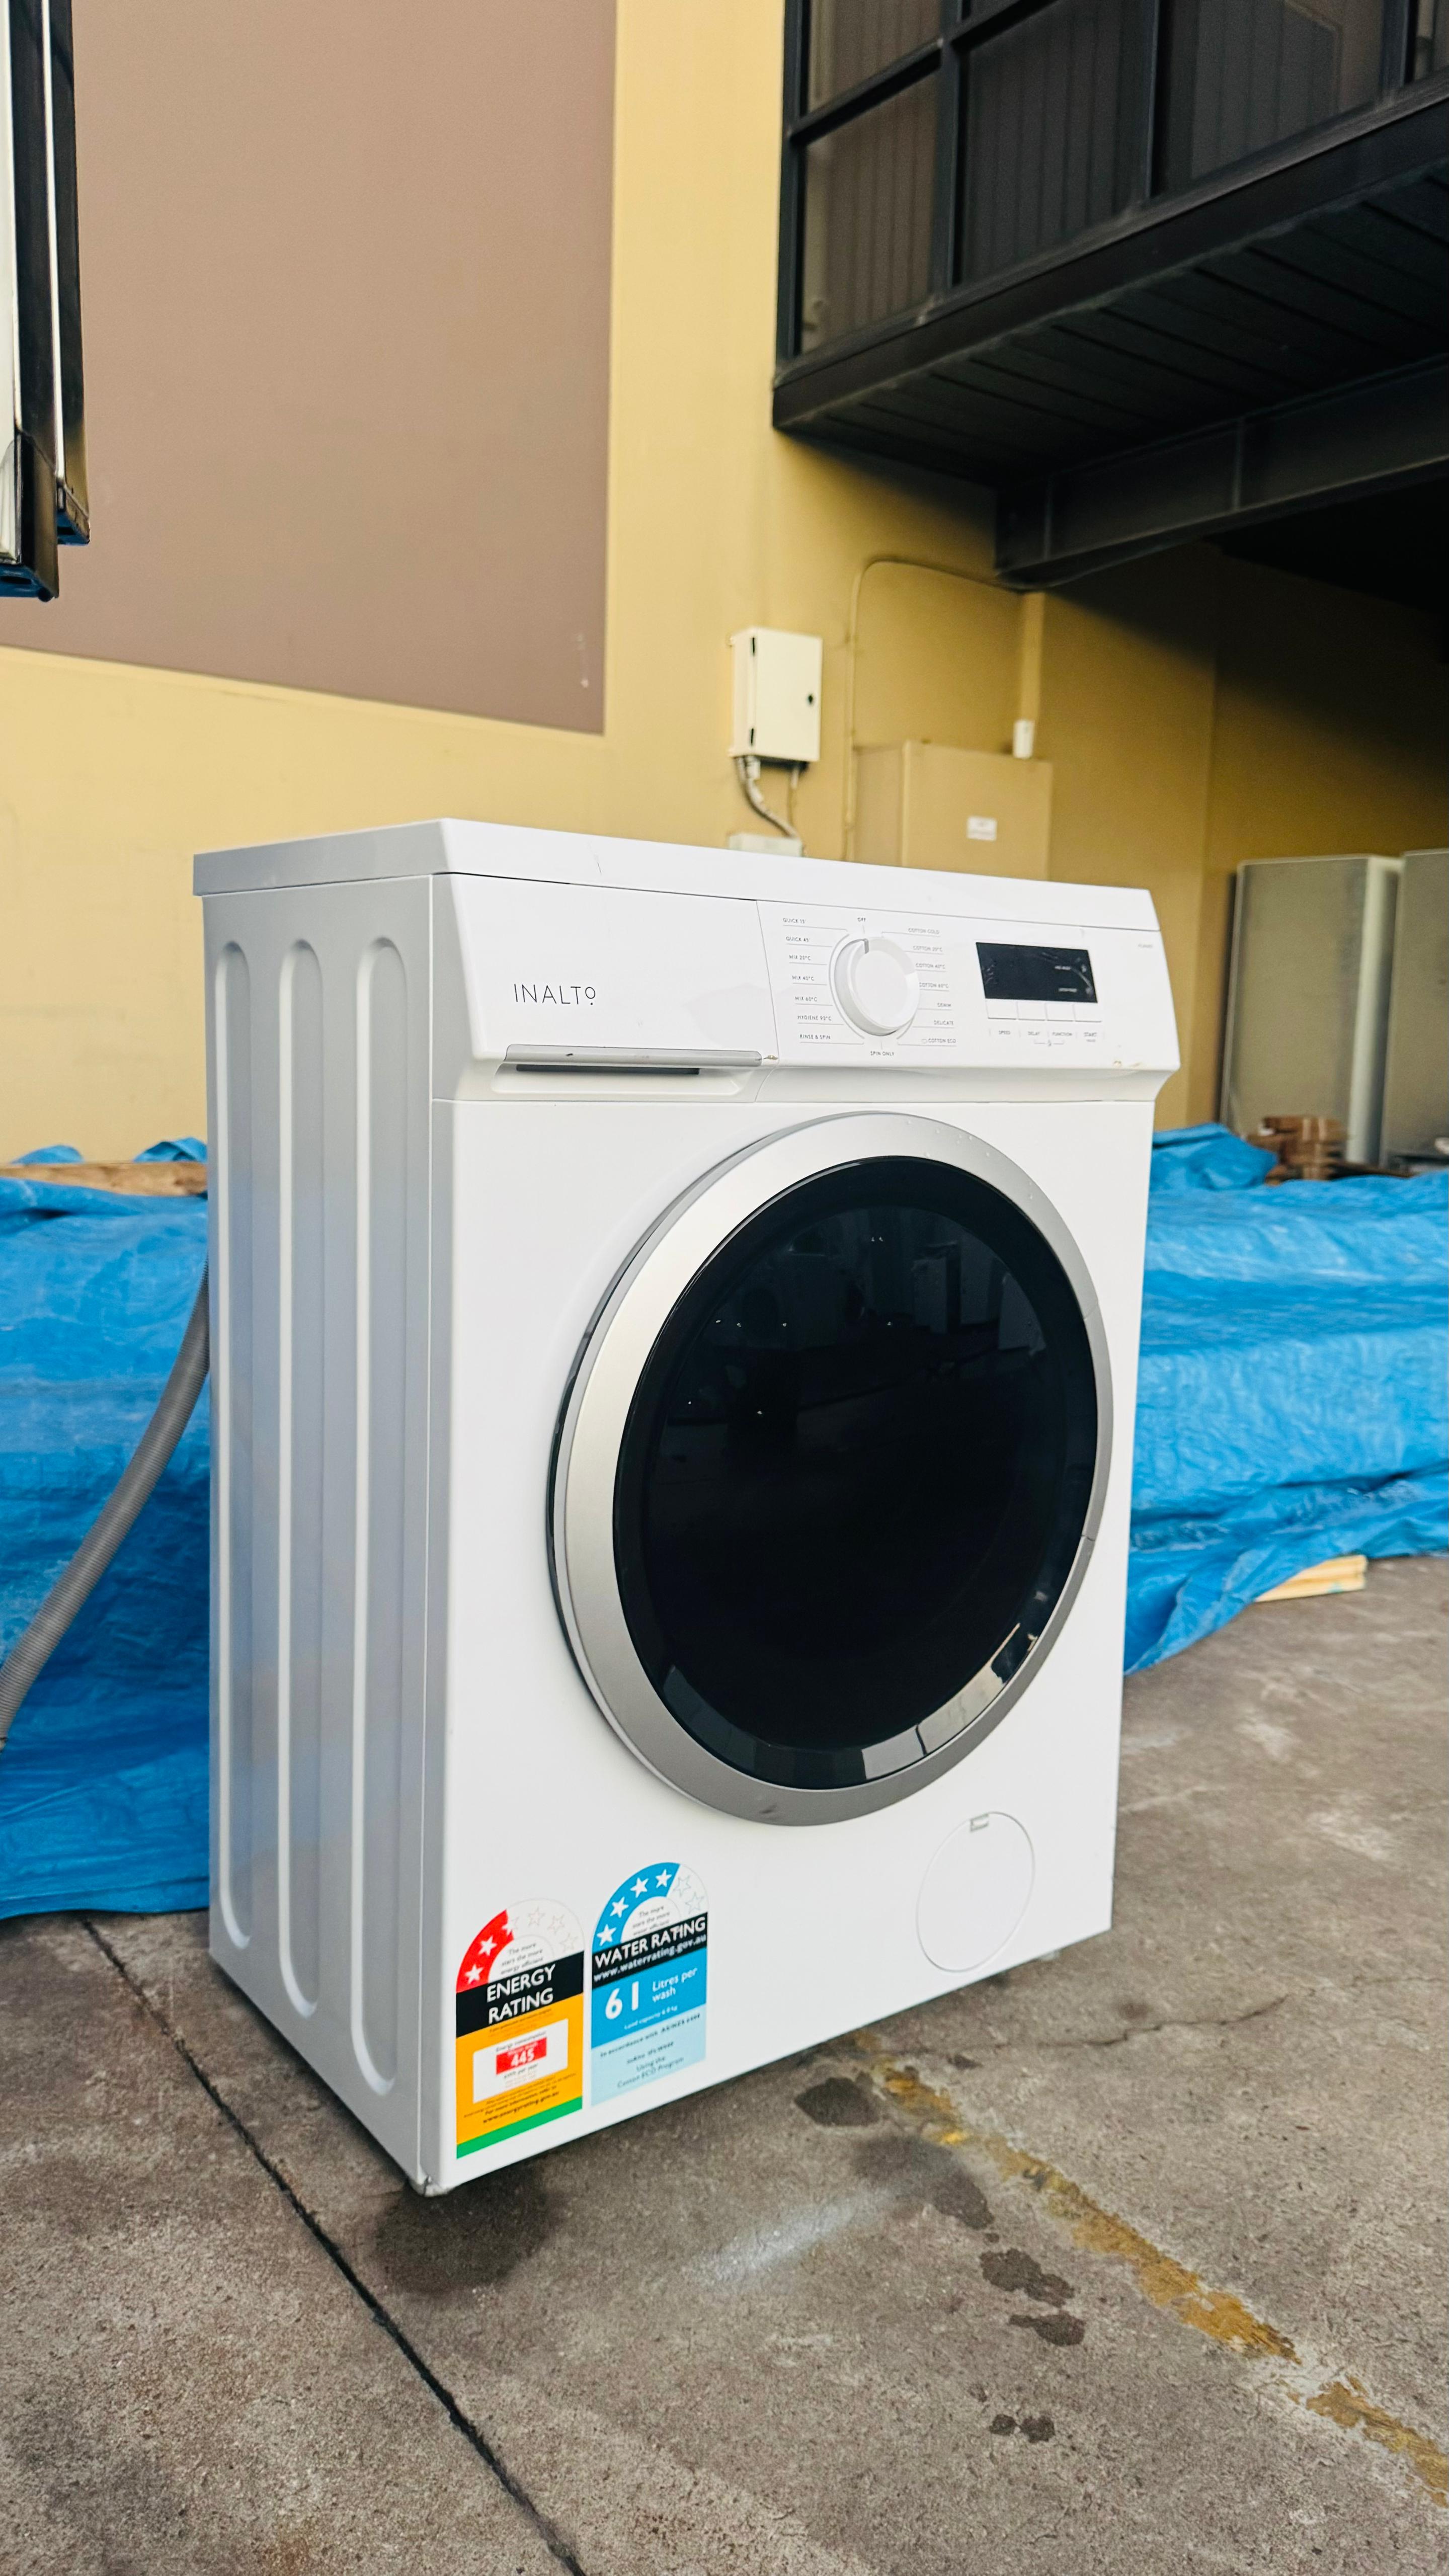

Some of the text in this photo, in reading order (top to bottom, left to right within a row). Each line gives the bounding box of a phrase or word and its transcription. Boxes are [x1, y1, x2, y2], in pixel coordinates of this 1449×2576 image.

[594, 1934, 707, 1982] www.waterrating.gov.au
[595, 1916, 705, 1969] WATER RATING
[487, 1964, 555, 2002] ENERGY
[652, 1975, 679, 1992] Litres
[681, 1967, 698, 1983] per
[652, 1986, 676, 2002] wash
[489, 1987, 553, 2025] RATING
[511, 2048, 535, 2066] 445
